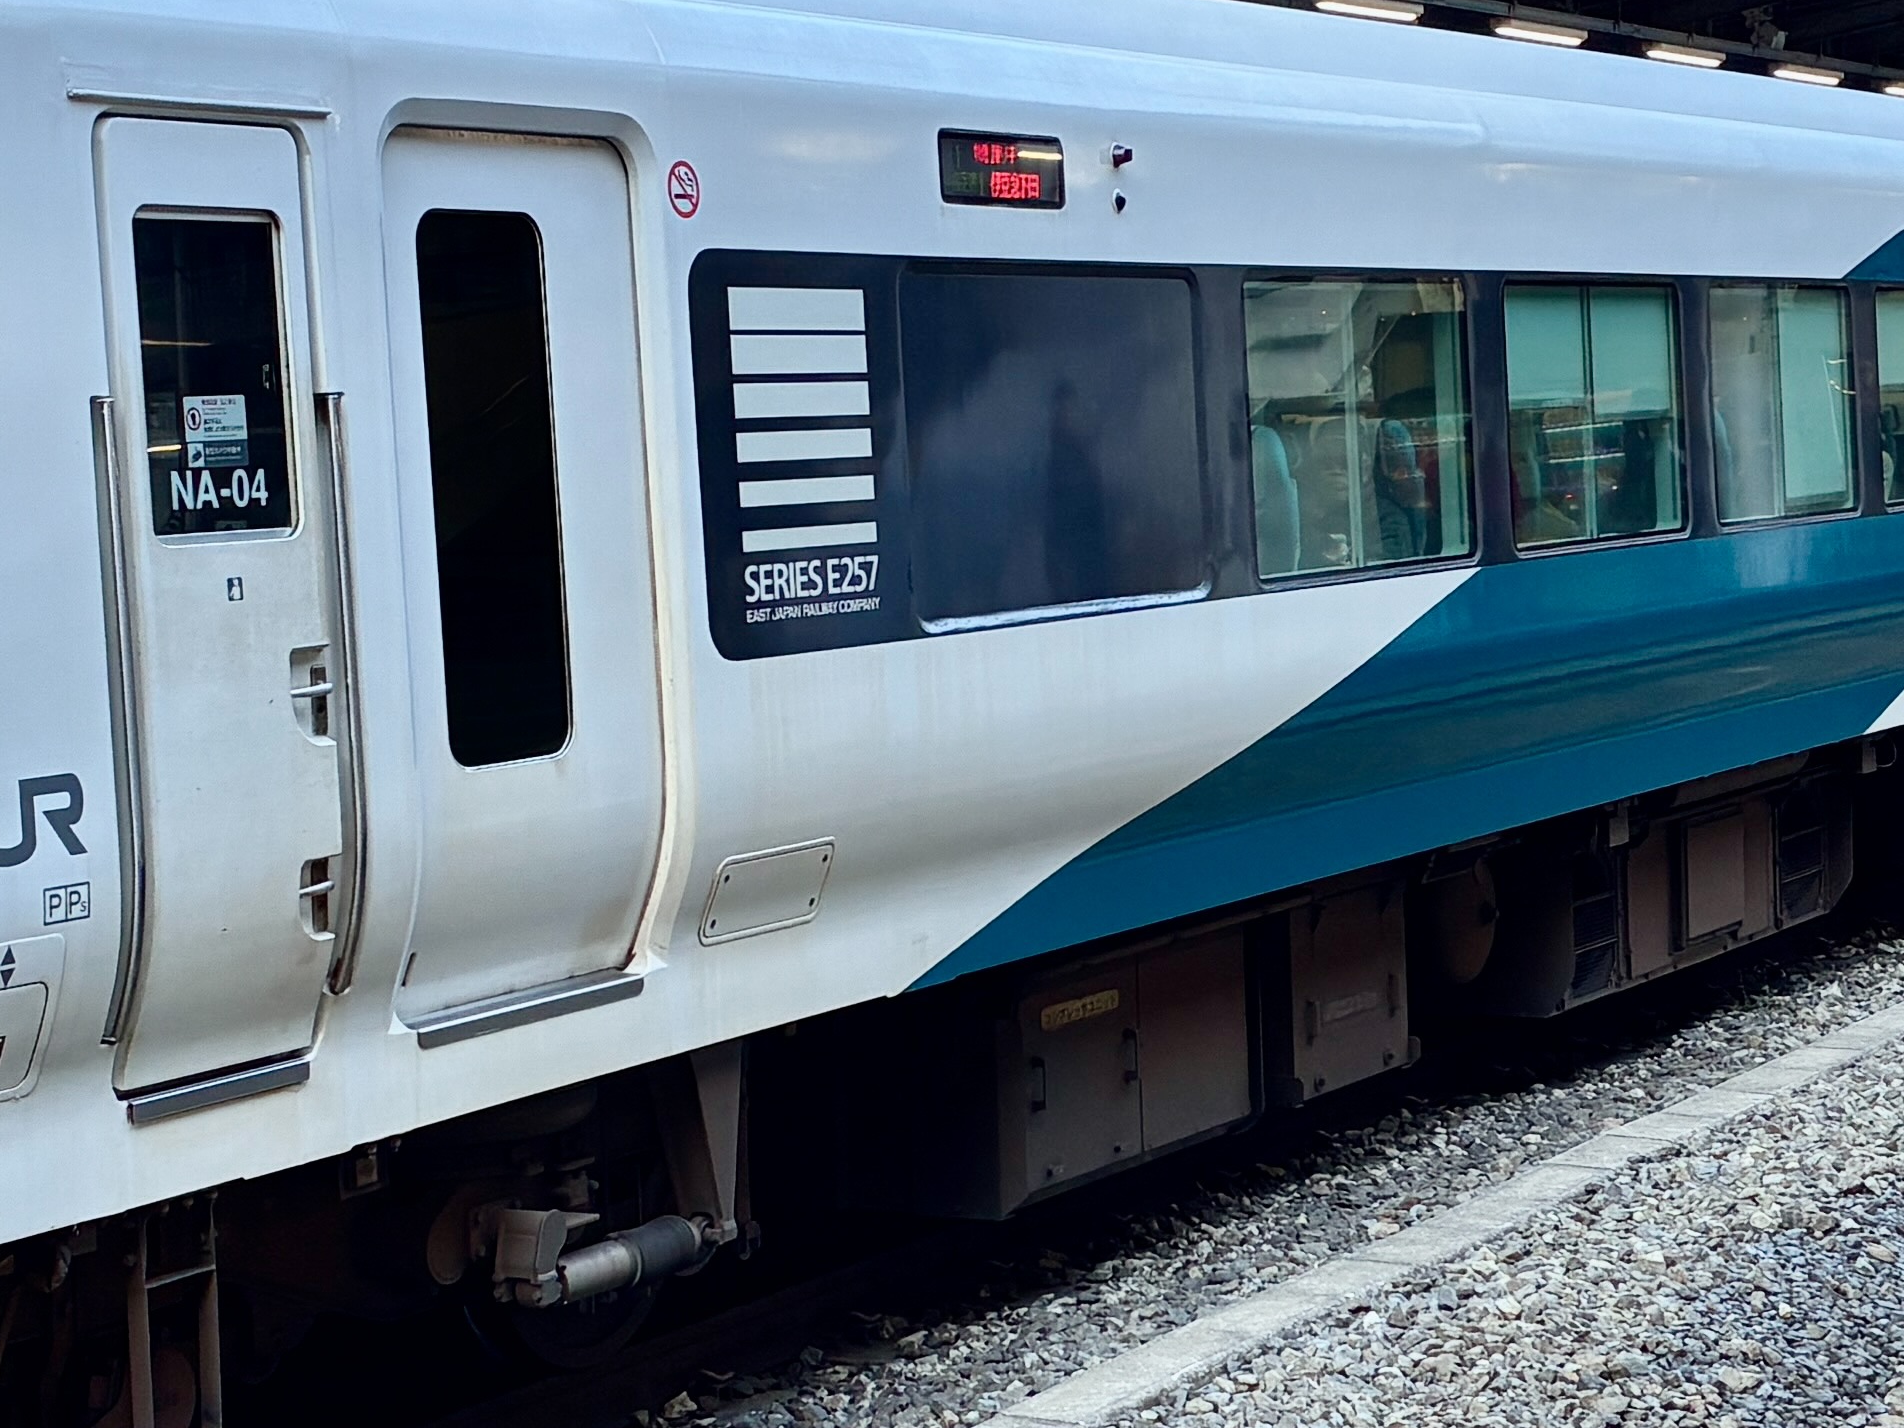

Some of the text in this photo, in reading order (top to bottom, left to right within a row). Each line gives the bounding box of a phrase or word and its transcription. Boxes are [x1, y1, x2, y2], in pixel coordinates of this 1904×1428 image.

[170, 468, 268, 510] NA-04
[744, 554, 879, 603] SERIES E257
[745, 596, 881, 623] EAST JAPAN RAILWAY COMPANY
